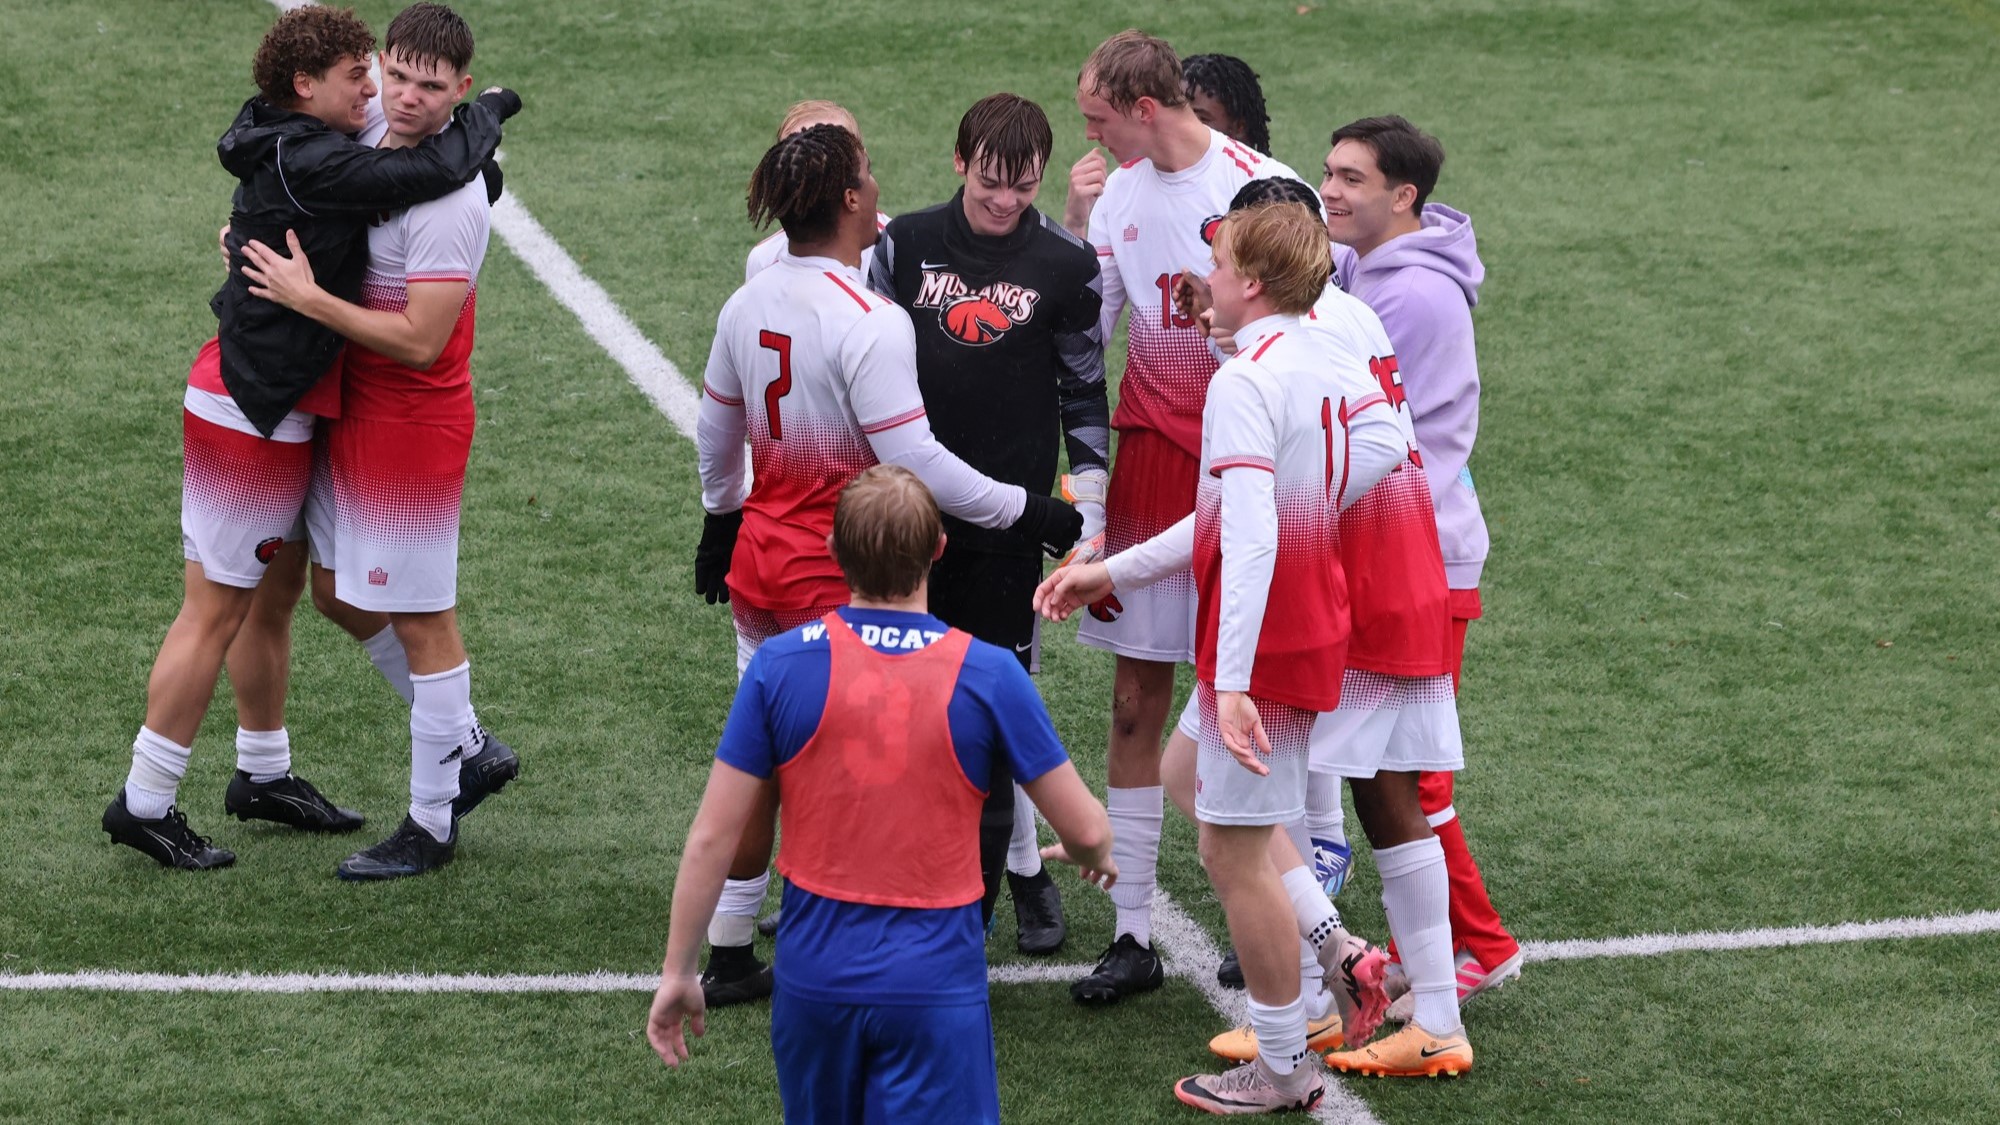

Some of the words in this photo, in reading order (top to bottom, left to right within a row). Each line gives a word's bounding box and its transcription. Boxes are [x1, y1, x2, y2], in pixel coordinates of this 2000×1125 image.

[913, 270, 1040, 325] MUSANGS
[759, 329, 791, 441] 7
[1321, 396, 1350, 512] 11
[843, 669, 910, 785] 3
